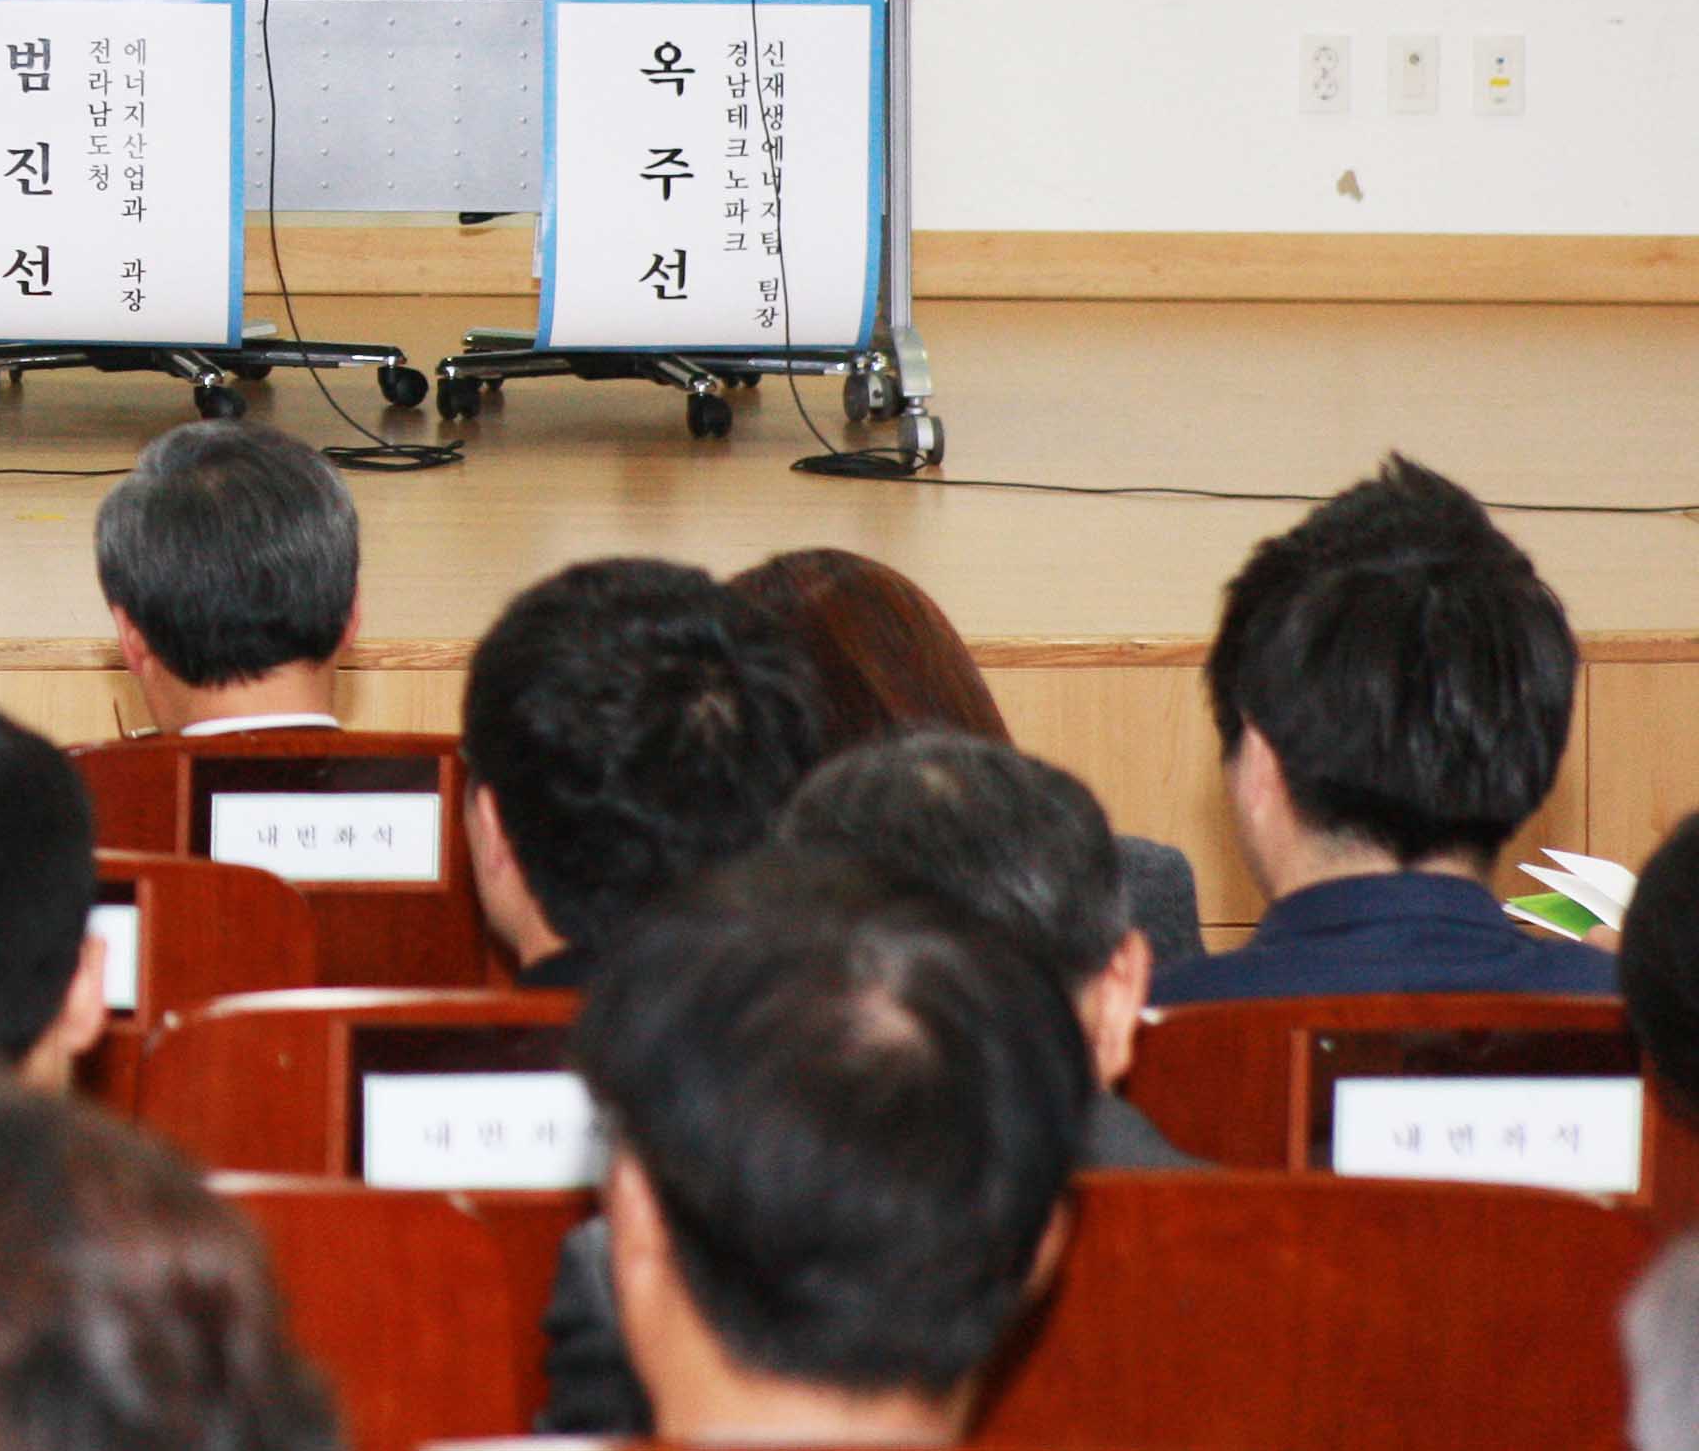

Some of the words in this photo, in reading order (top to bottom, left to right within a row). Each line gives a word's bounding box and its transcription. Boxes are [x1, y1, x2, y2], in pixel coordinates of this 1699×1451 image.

[87, 37, 114, 193] 전라남도청
[120, 37, 148, 224] 에너지산업과
[723, 39, 752, 254] 경남테크노파크
[760, 39, 786, 257] 신재생에너지팀
[119, 257, 148, 314] 과장
[755, 277, 780, 329] 팀장
